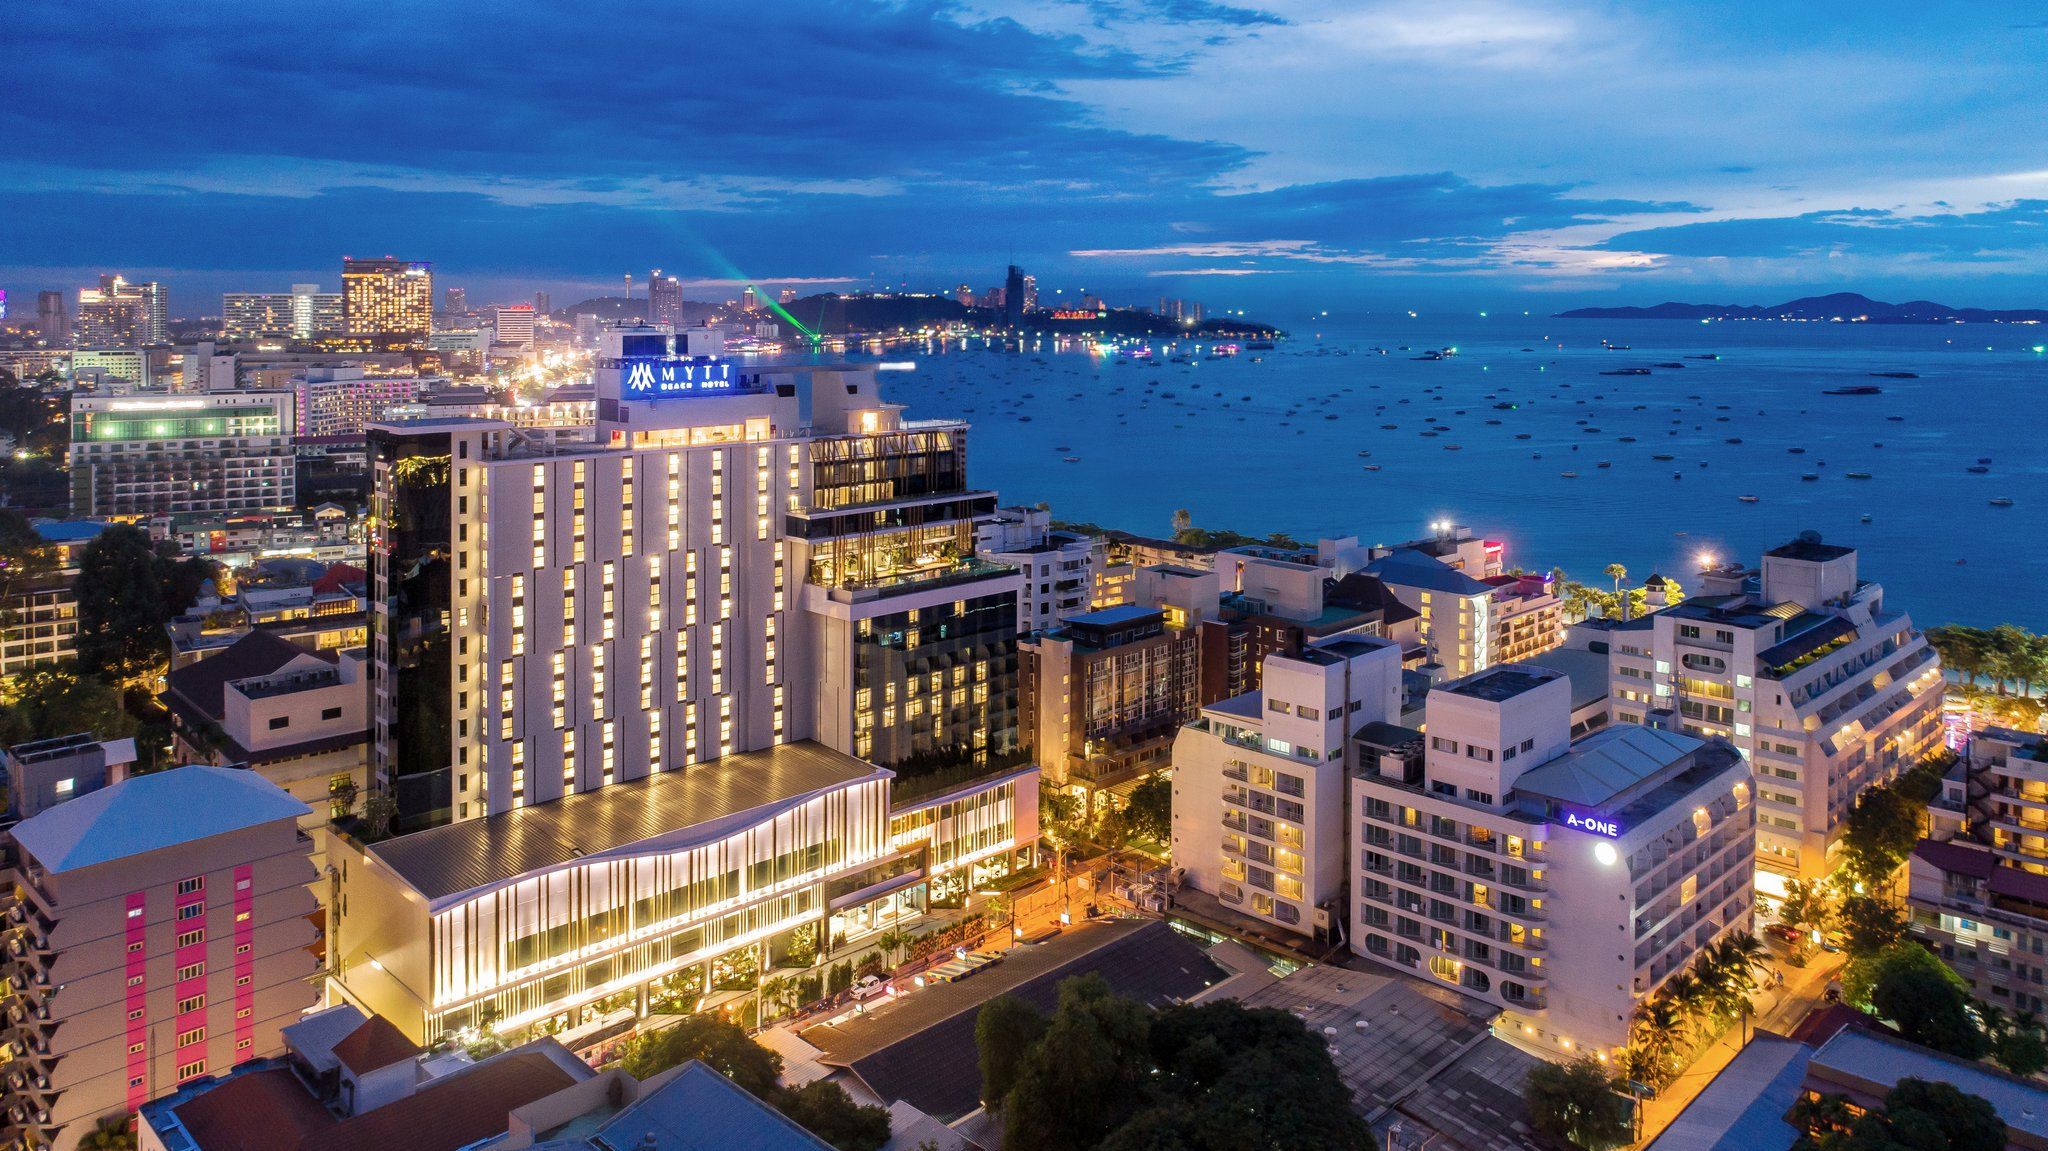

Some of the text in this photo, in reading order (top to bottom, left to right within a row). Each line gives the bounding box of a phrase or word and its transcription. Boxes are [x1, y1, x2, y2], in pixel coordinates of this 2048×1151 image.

[662, 364, 730, 382] MYTT
[661, 380, 730, 391] BEACH HOTEL
[1567, 813, 1618, 837] A-ONE
